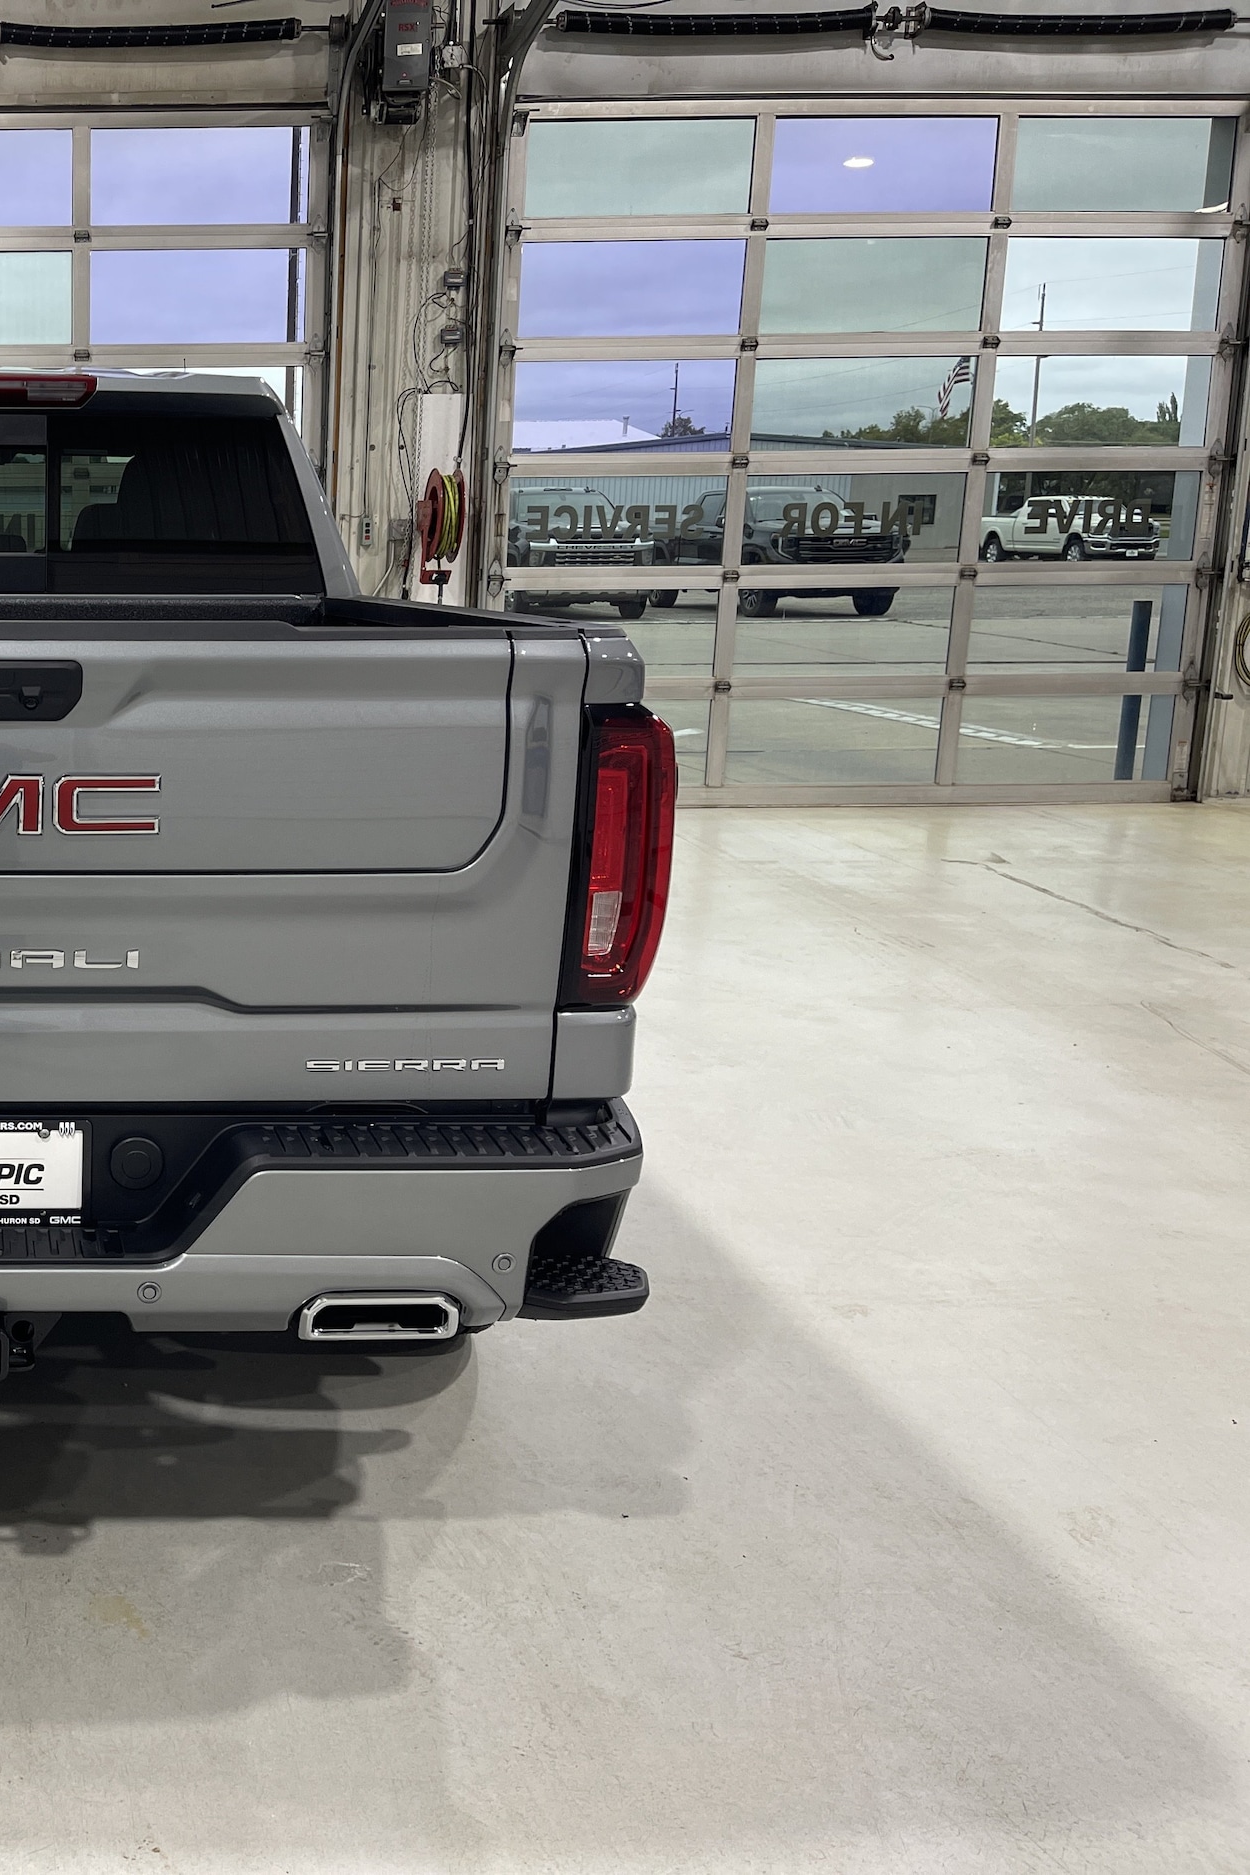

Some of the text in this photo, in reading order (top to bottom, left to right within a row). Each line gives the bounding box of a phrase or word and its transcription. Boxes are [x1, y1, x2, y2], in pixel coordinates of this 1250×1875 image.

[305, 1058, 505, 1072] SIERRA
[0, 1194, 20, 1206] SD
[29, 1217, 41, 1225] SD
[49, 1216, 81, 1225] GMC
